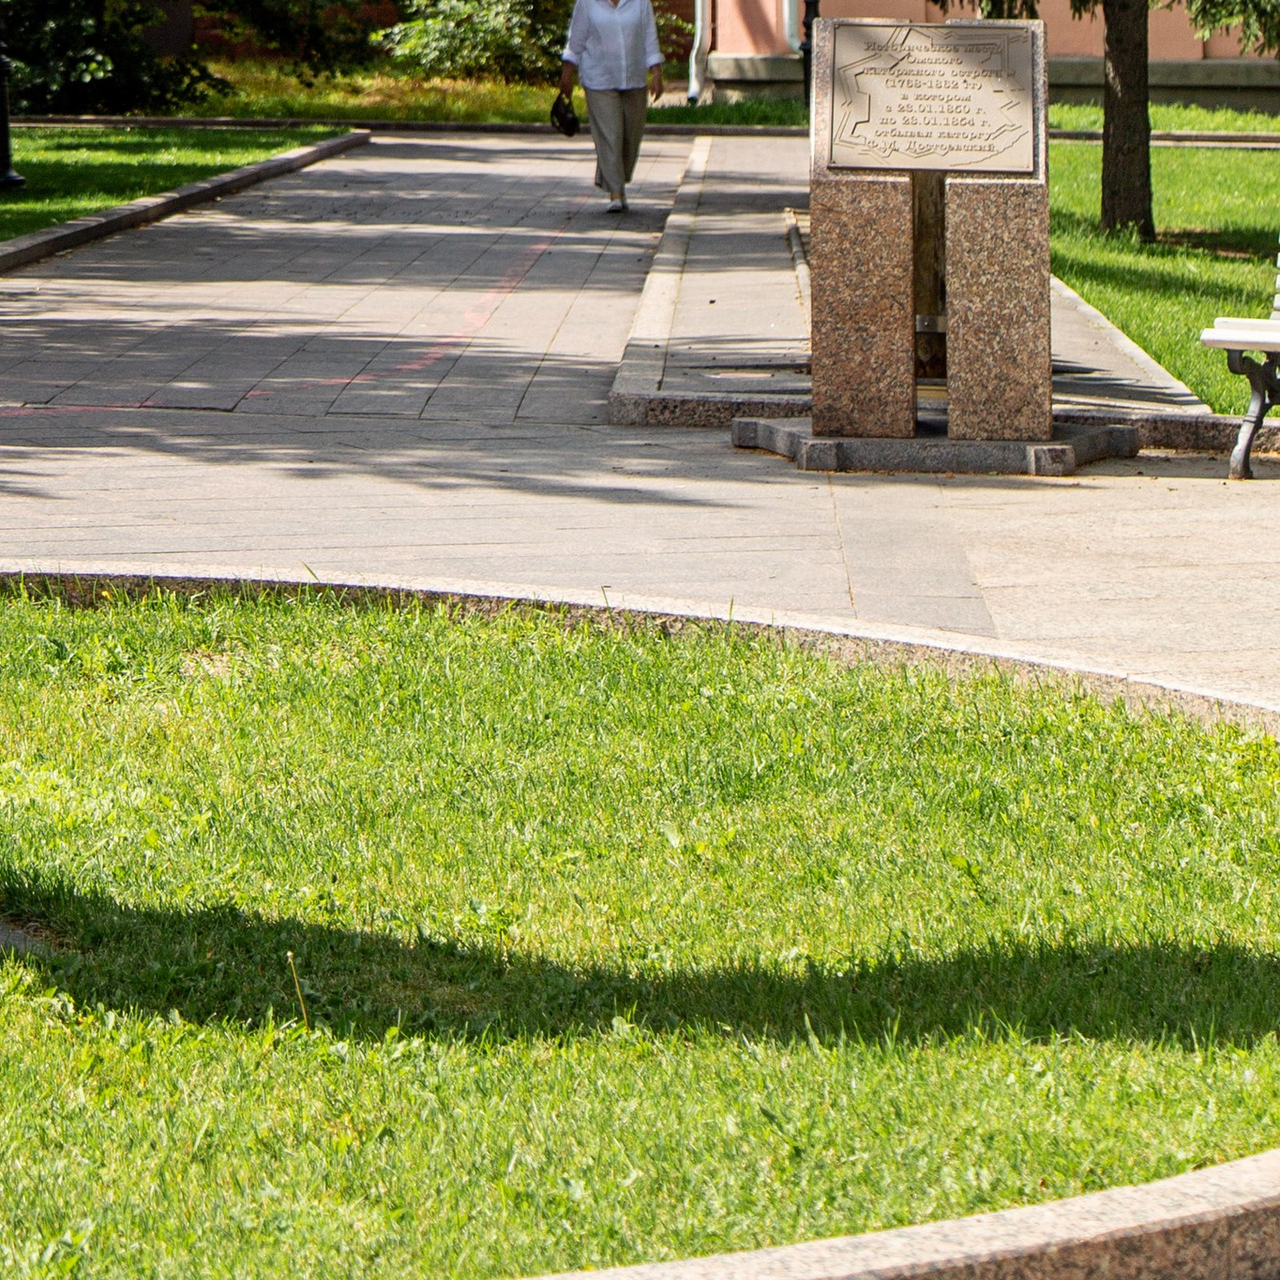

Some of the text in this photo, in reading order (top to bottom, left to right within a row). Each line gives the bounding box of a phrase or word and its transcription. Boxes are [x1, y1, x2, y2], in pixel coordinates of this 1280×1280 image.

[907, 54, 963, 65] Омского
[914, 93, 972, 103] котором
[975, 106, 987, 115] г.
[879, 117, 897, 126] по
[980, 119, 992, 127] г.
[874, 127, 992, 141] отбывал каторгу
